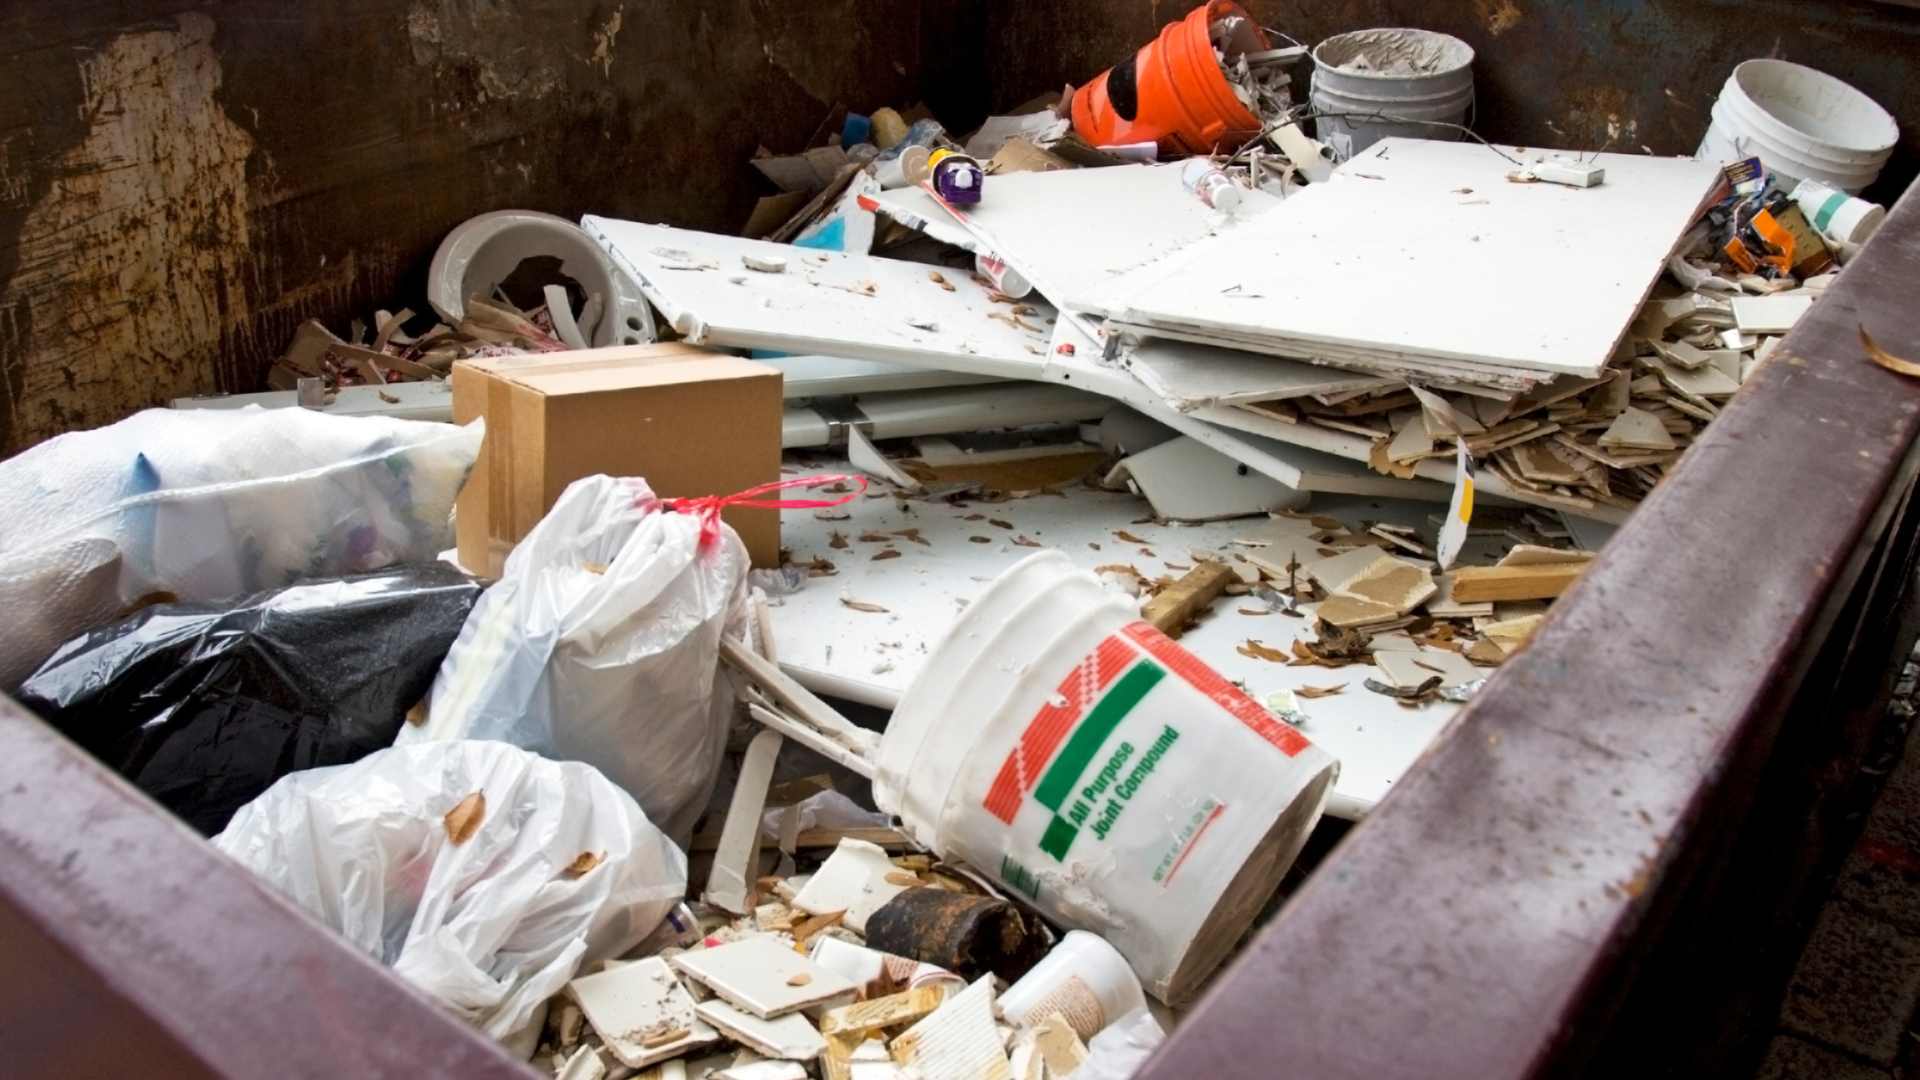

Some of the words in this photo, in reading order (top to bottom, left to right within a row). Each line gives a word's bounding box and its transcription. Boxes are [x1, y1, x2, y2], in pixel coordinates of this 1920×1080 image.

[1068, 800, 1091, 826] All
[1081, 741, 1134, 803] Purpose
[1090, 798, 1124, 840] Joint
[1114, 724, 1179, 800] Compound
[1152, 865, 1165, 882] NET
